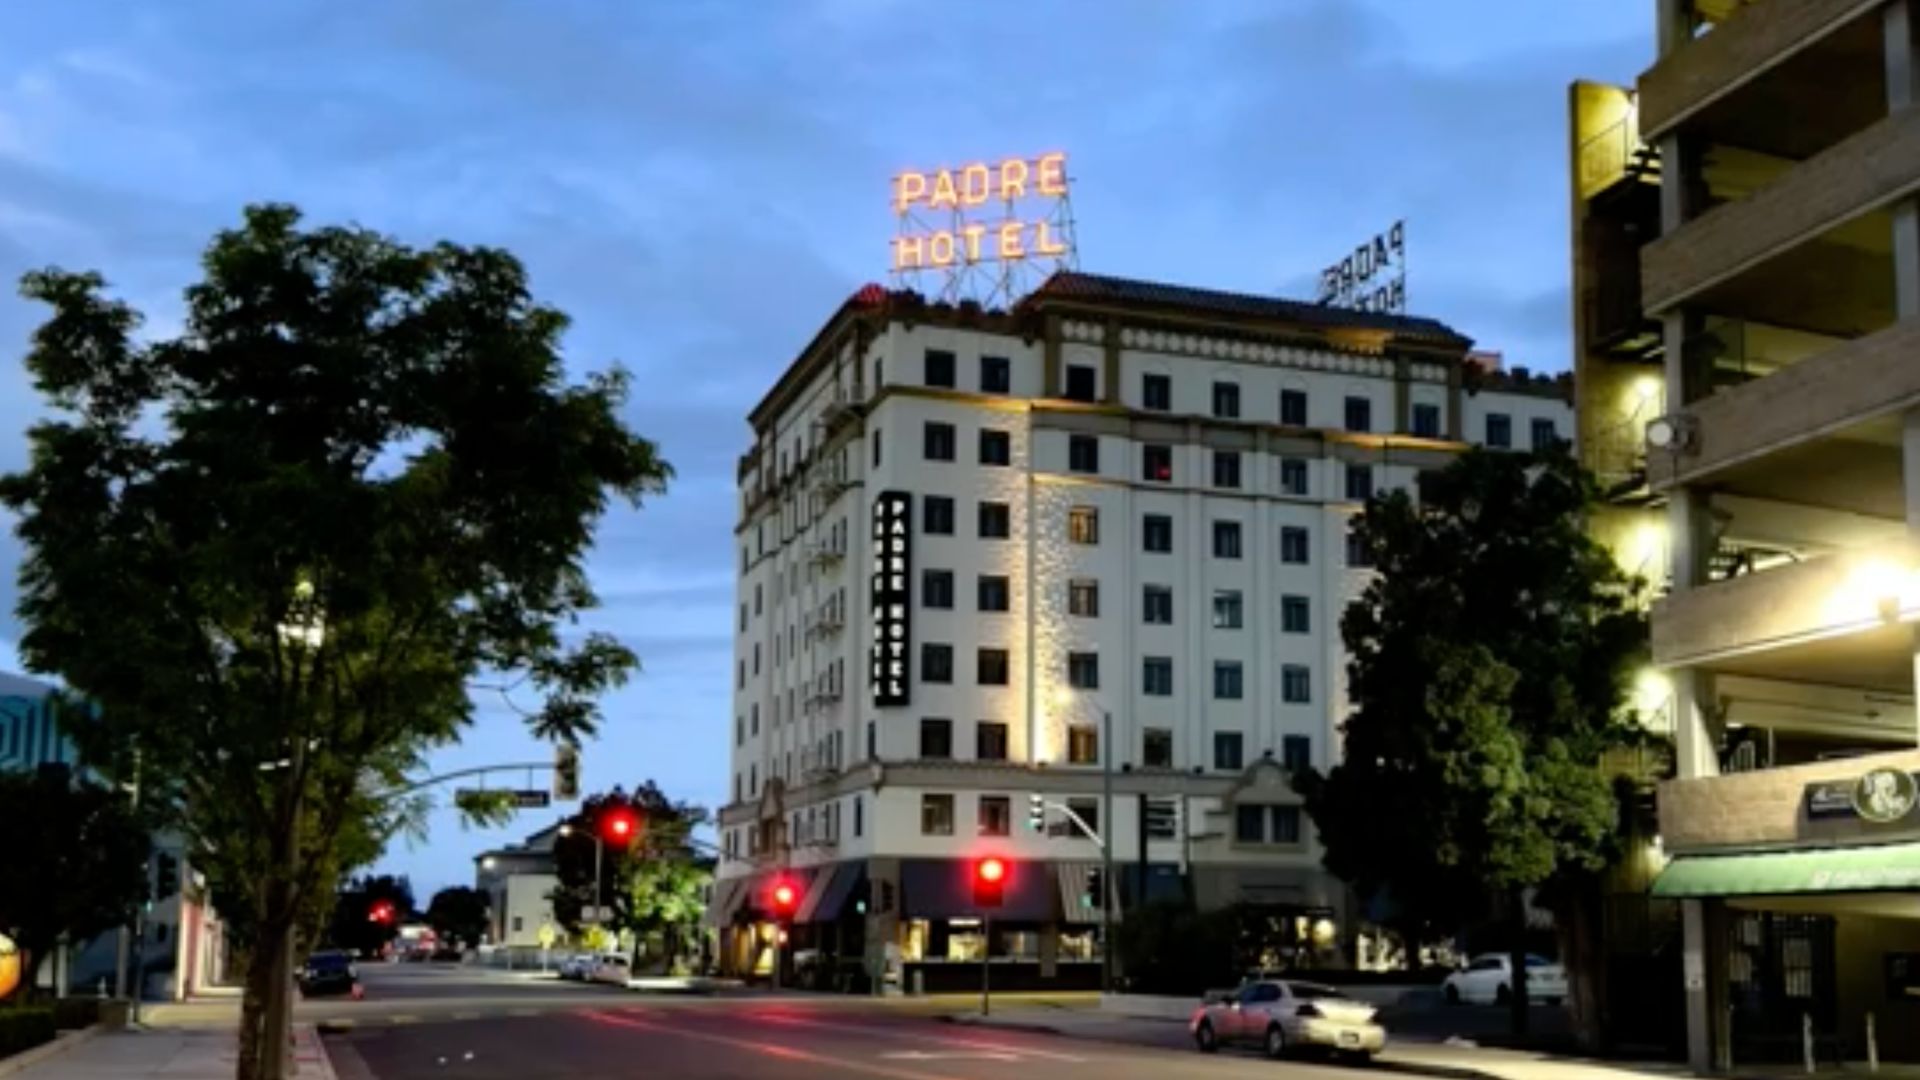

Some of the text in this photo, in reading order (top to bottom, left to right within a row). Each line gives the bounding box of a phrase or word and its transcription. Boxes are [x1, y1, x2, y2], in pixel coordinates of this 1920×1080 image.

[896, 152, 1067, 214] PADRE
[896, 220, 1067, 270] HOTEL
[889, 500, 905, 697] PADRE HOTEL
